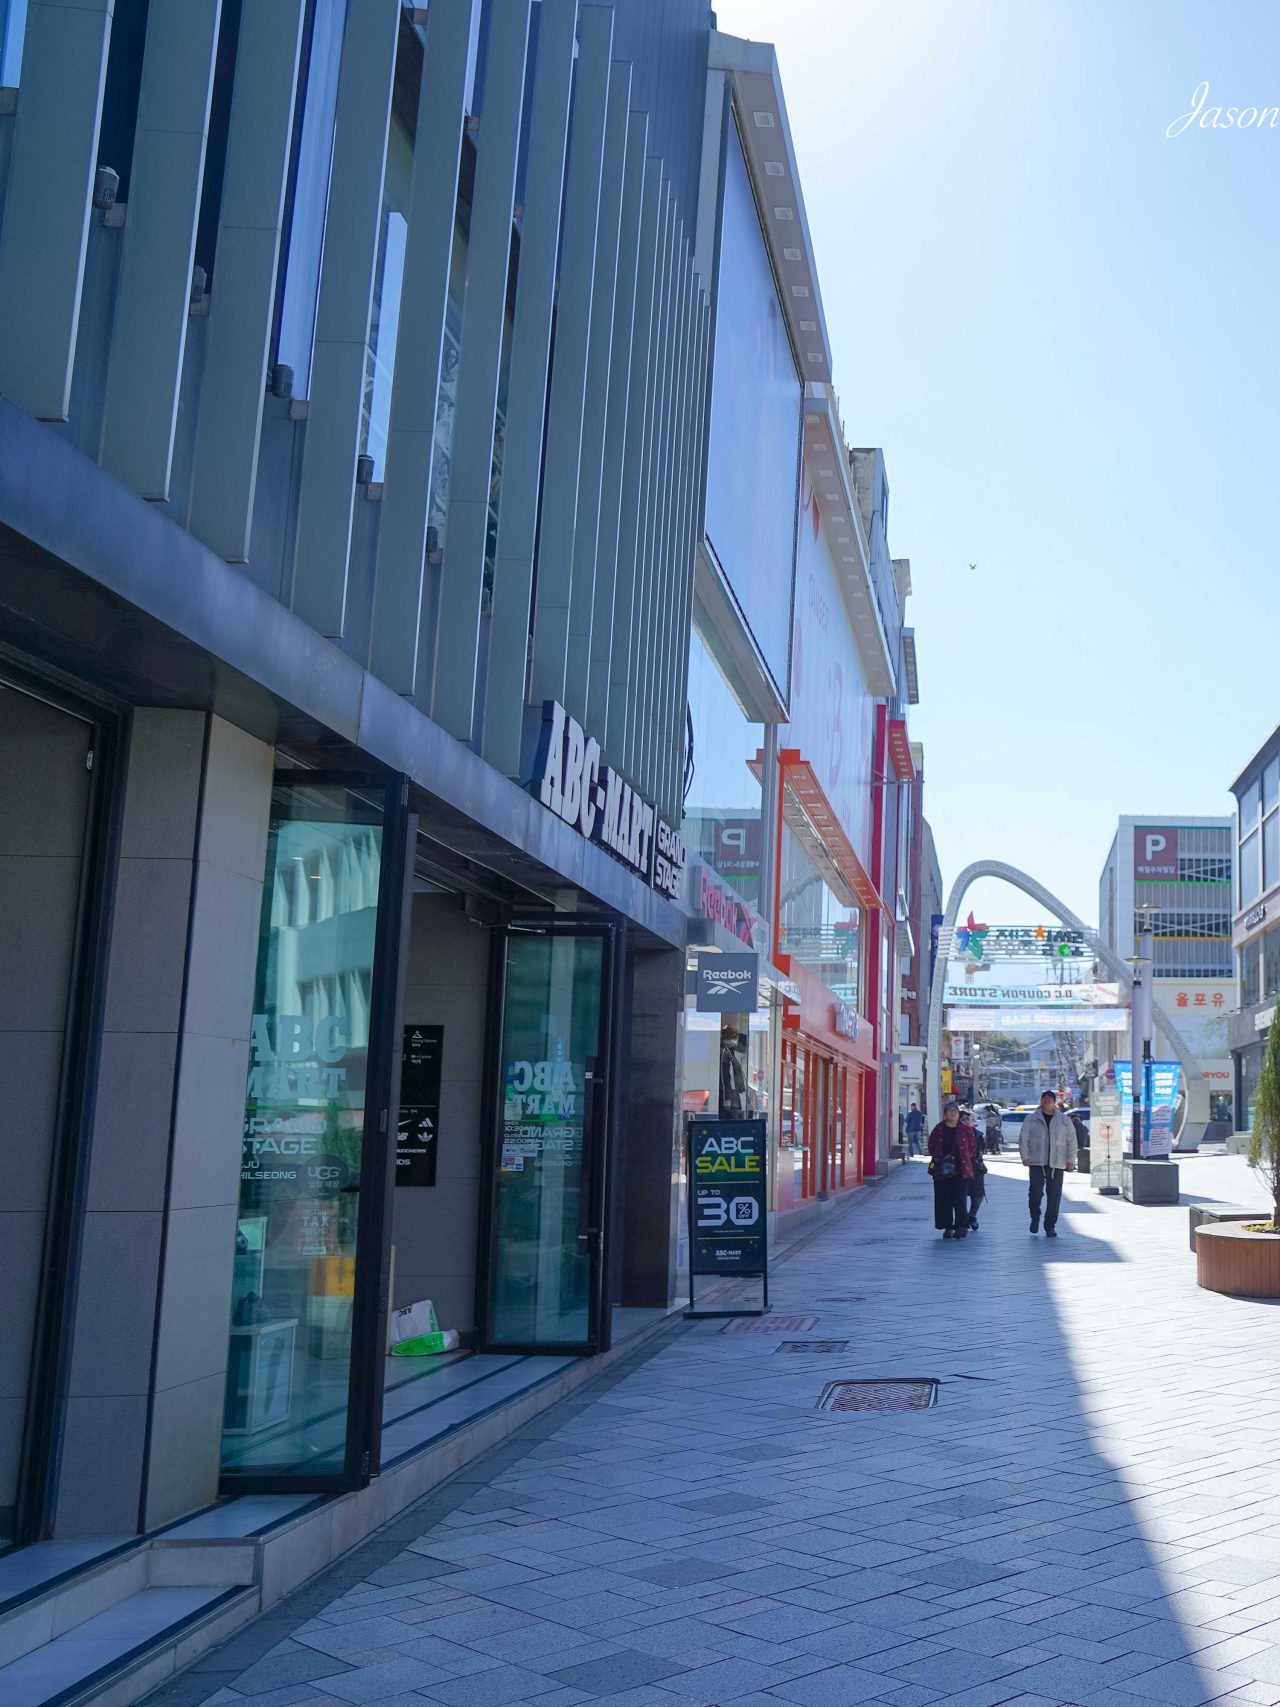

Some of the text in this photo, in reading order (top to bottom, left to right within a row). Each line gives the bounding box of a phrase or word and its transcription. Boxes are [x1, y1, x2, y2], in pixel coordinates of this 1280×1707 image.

[540, 700, 654, 875] ABC-MART
[1145, 834, 1166, 861] P
[703, 969, 751, 980] Reebok
[1175, 992, 1225, 1007] 올포유
[244, 1117, 327, 1134] RAND
[701, 1137, 754, 1154] ABC
[696, 1155, 760, 1173] SALE
[307, 1166, 340, 1180] UGG
[697, 1196, 759, 1226] 30
[303, 1215, 330, 1228] TAX
